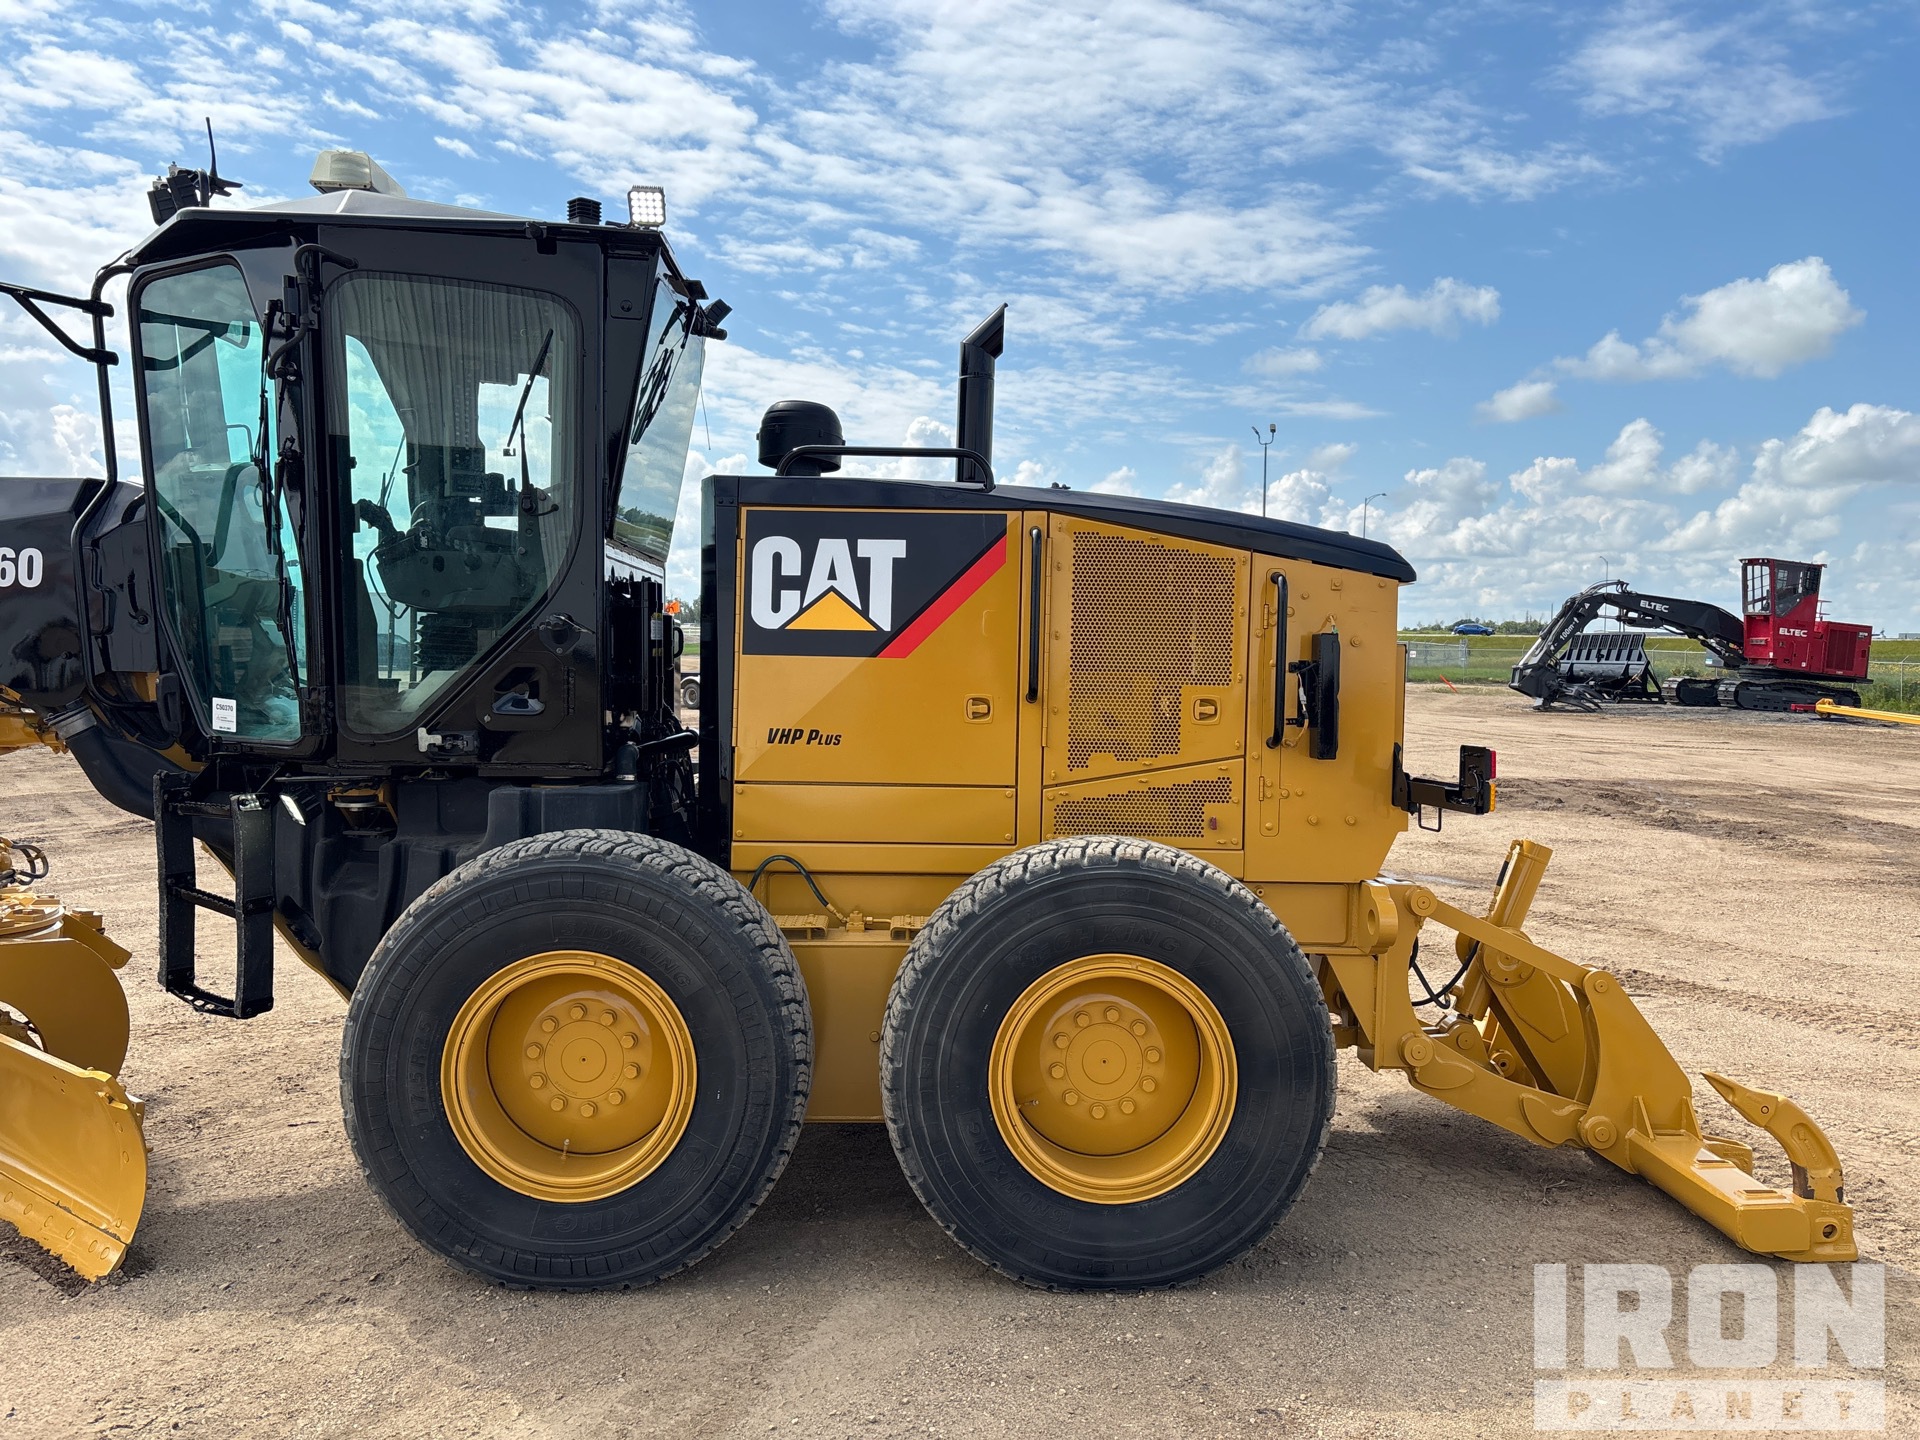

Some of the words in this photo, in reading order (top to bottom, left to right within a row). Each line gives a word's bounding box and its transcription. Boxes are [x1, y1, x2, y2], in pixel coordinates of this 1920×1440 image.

[751, 535, 907, 631] CAT
[1639, 600, 1670, 613] ELTEC
[1778, 627, 1808, 638] ELTEC
[767, 727, 805, 745] VHP
